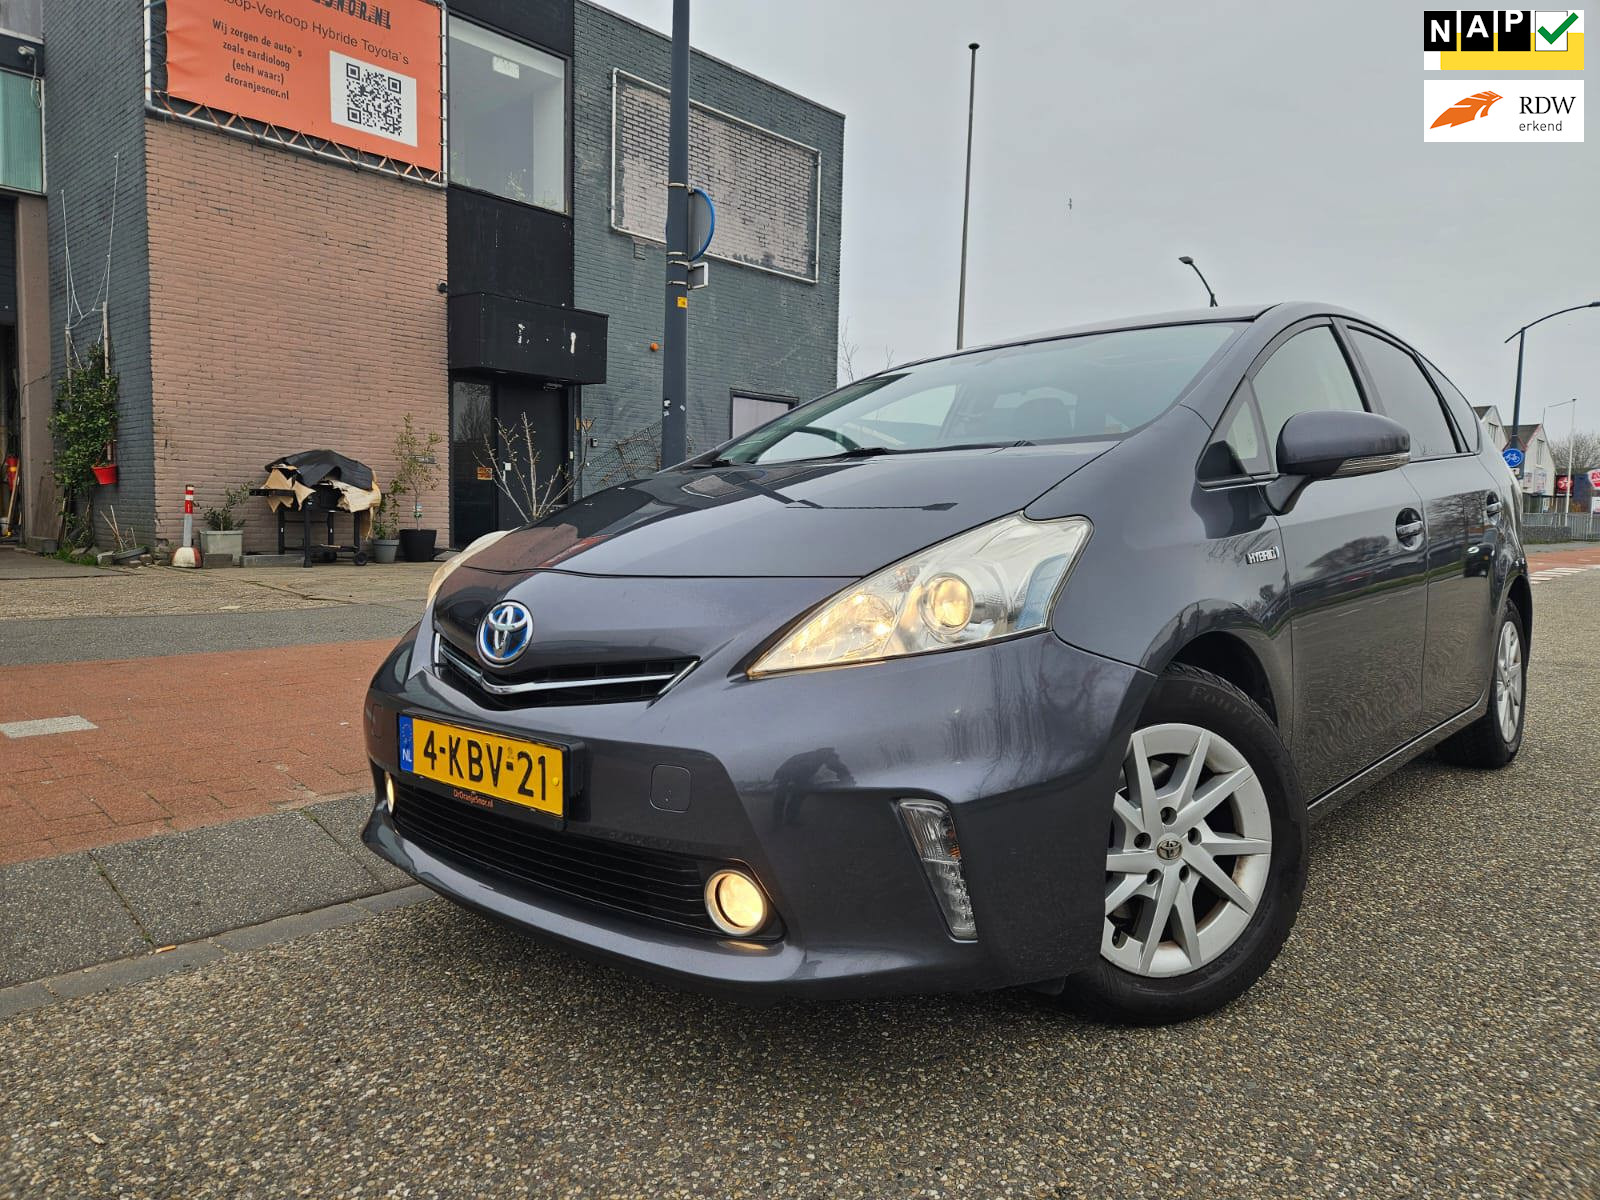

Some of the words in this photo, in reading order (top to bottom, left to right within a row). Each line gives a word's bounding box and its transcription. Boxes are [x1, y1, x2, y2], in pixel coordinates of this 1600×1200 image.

[212, 18, 228, 35] Wij
[230, 27, 259, 42] zorgen
[261, 35, 272, 47] de
[312, 22, 358, 47] Hybride
[223, 41, 245, 55] zoals
[247, 49, 290, 70] cardioloog
[232, 59, 256, 74] (echt
[224, 73, 289, 100] droranjesnor.nl
[1246, 549, 1277, 564] HYBRID
[402, 749, 412, 762] NL
[423, 730, 547, 801] 4-KBV-21
